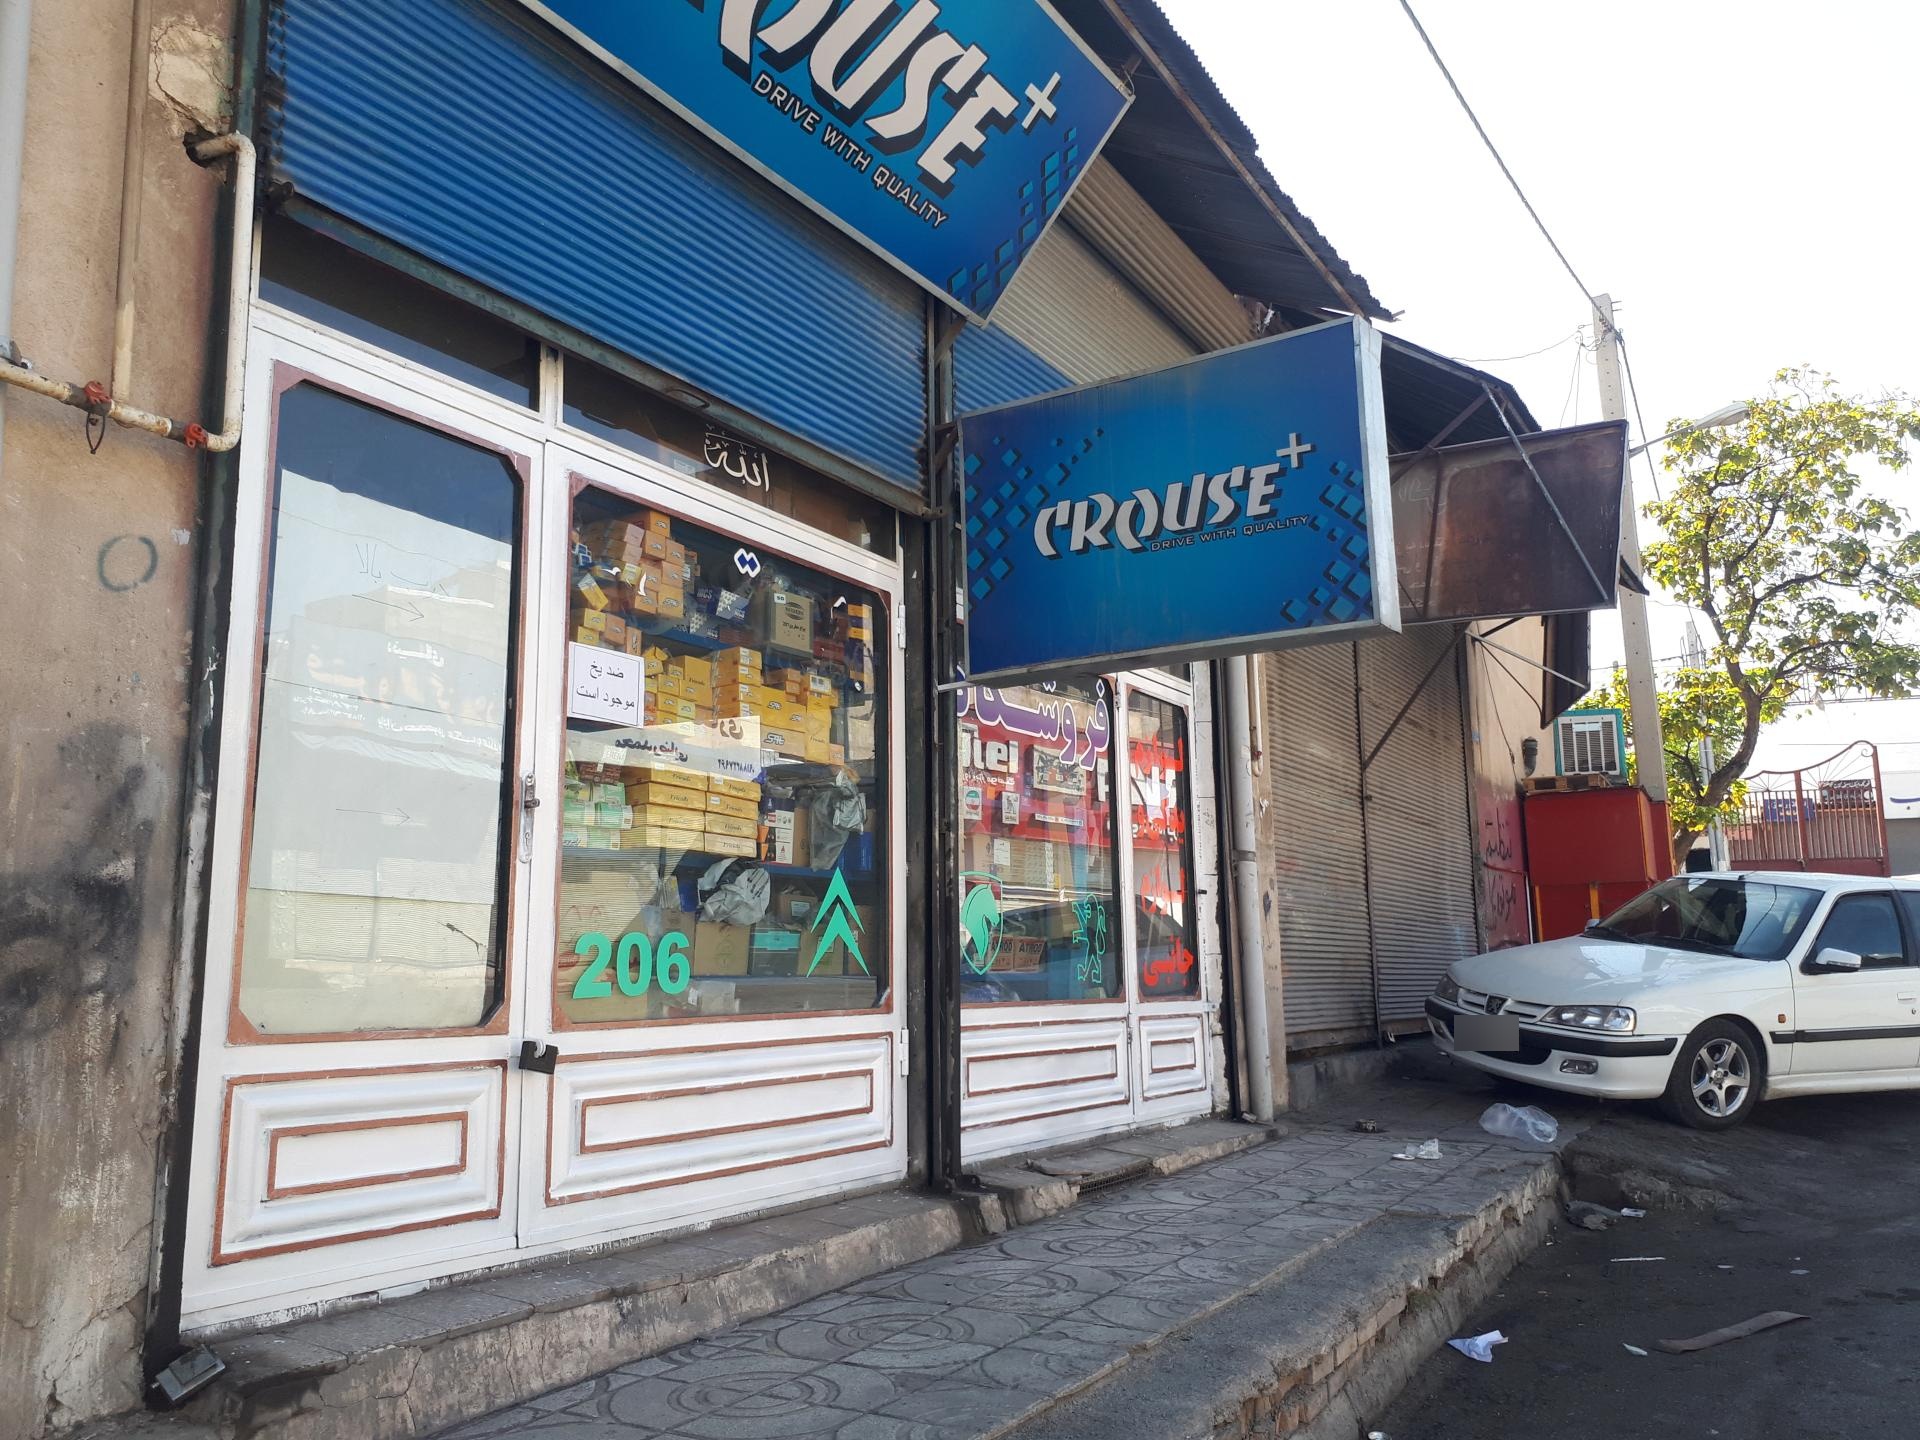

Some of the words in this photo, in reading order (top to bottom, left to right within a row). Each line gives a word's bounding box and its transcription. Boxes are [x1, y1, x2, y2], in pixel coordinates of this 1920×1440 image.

[752, 72, 821, 132] DRIVE
[821, 124, 871, 172] WITH
[871, 164, 950, 229] QUALITY
[1150, 534, 1196, 552] DRIVE
[1199, 527, 1237, 543] WITH
[1242, 513, 1310, 537] QUALITY
[588, 660, 603, 679] یخ
[606, 664, 624, 679] ضد
[576, 685, 600, 701] است
[602, 690, 635, 710] موجود
[572, 931, 691, 999] 206
[1143, 932, 1194, 988] جانبی
